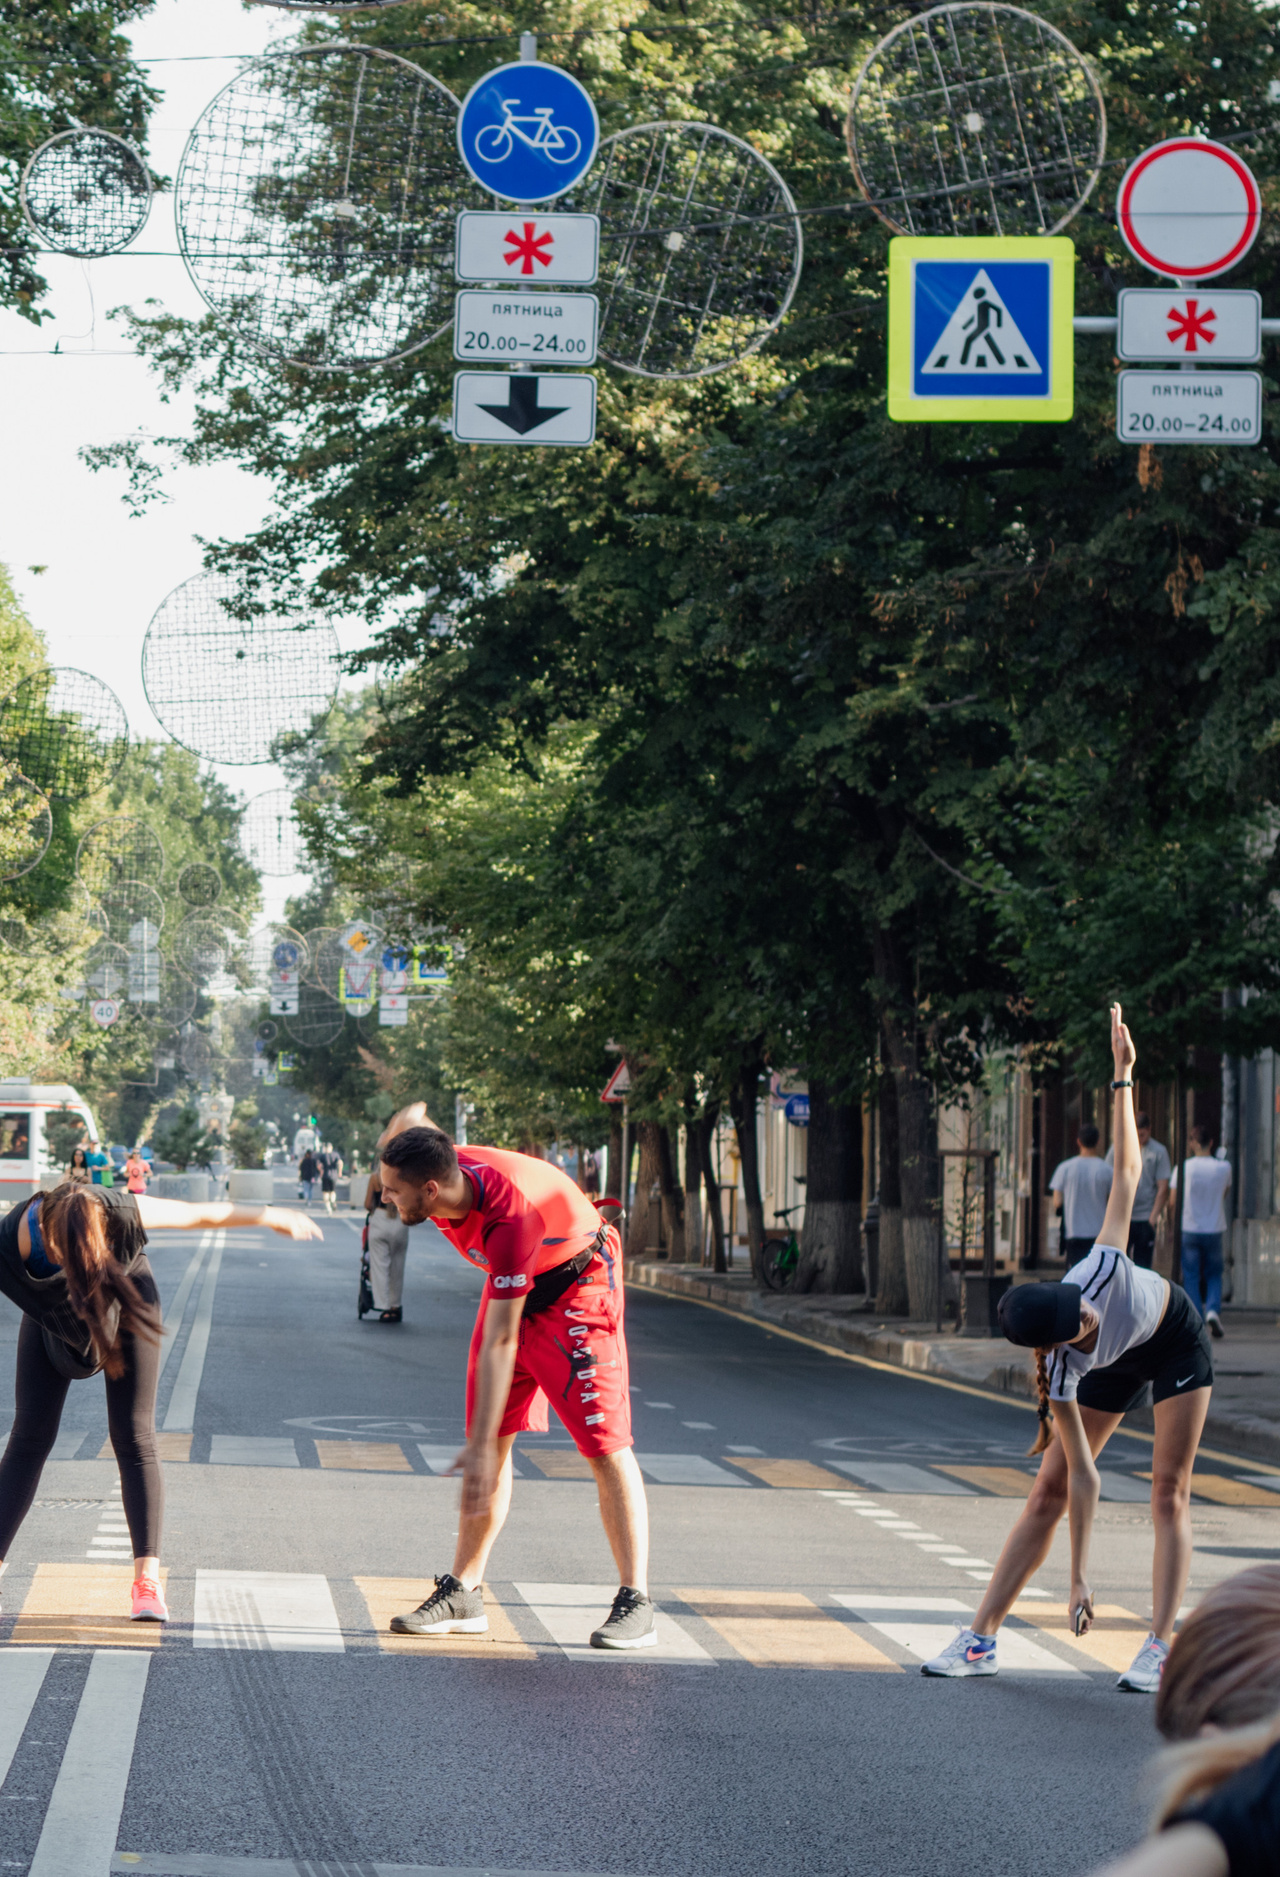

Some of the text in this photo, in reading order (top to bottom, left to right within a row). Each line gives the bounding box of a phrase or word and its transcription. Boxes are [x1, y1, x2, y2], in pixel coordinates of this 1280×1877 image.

[492, 303, 563, 318] пятница
[1152, 384, 1223, 398] пятница
[97, 1006, 113, 1018] 40
[493, 1273, 527, 1289] QNB
